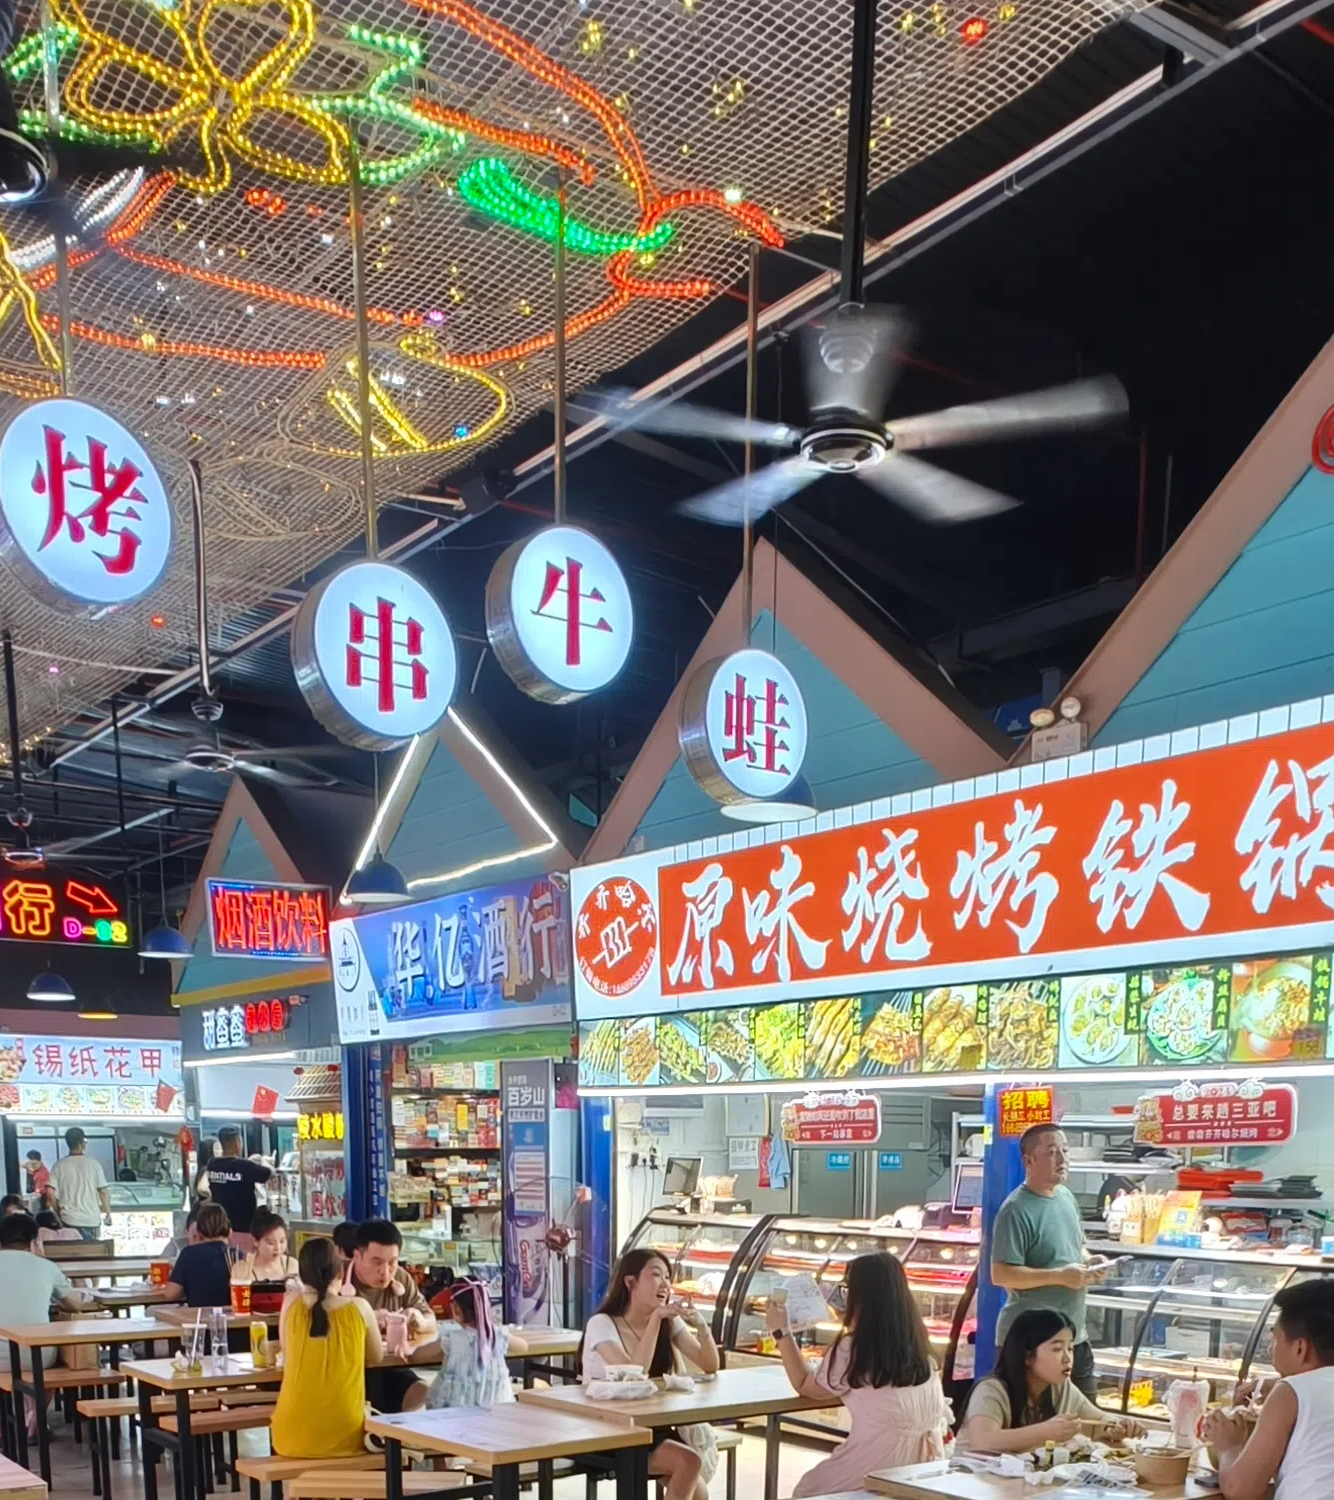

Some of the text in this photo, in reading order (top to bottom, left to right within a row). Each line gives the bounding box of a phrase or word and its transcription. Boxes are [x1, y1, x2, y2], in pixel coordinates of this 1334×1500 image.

[32, 424, 148, 576] 烤
[346, 596, 428, 713] 串
[529, 556, 613, 666] 牛
[723, 673, 791, 777] 蛙
[215, 886, 327, 953] 烟酒饮料
[391, 892, 558, 999] 华亿酒行
[32, 1043, 163, 1080] 锡纸花甲
[507, 1085, 546, 1107] 百岁山
[1001, 1090, 1050, 1110] 招聘
